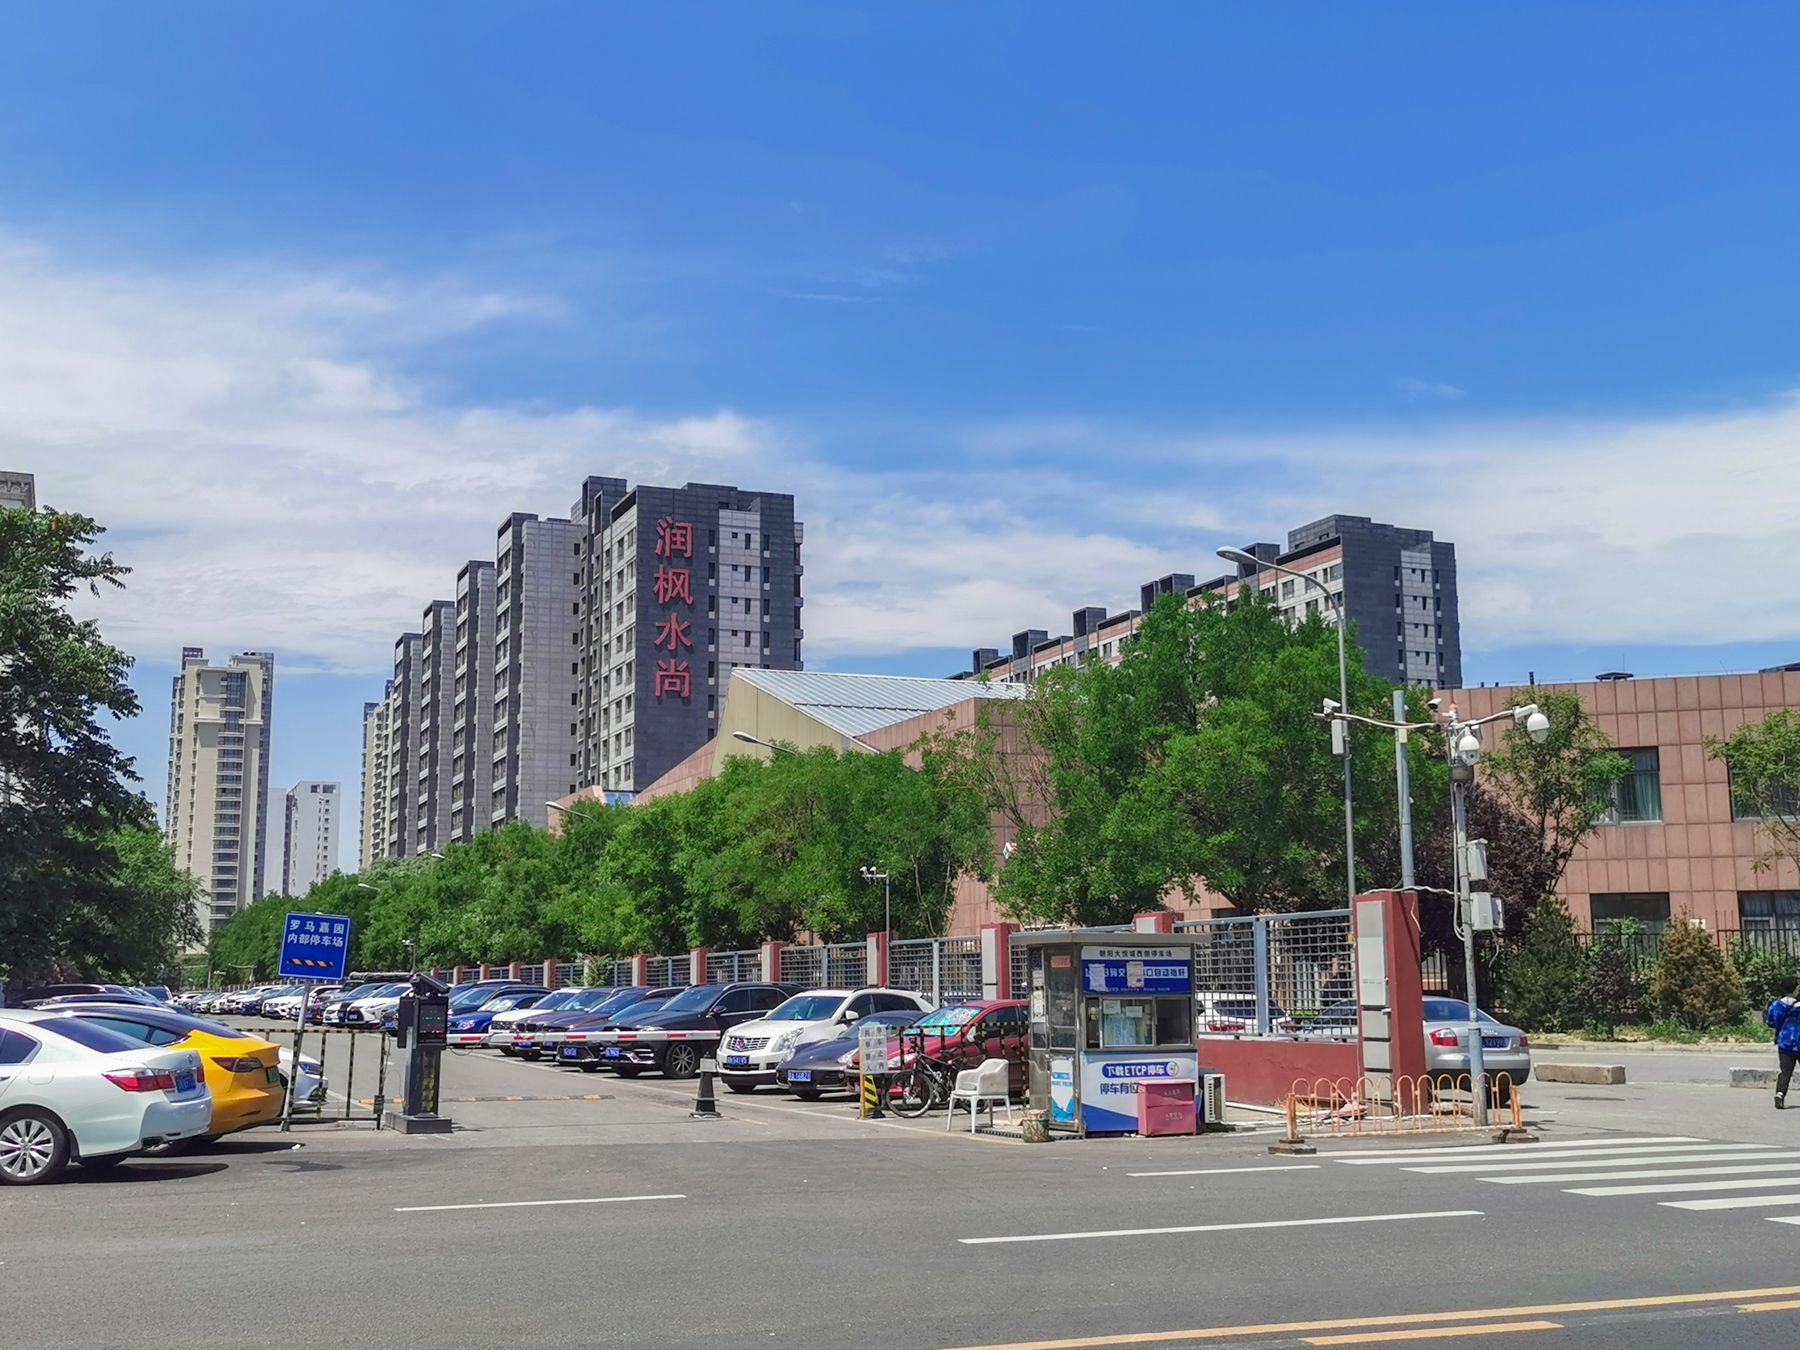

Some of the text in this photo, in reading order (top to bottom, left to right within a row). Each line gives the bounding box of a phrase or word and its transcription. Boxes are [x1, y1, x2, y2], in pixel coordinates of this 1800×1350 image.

[653, 516, 694, 698] 润枫水尚
[288, 933, 343, 947] 内部停车场
[1106, 1064, 1166, 1077] 下载ETCP停车
